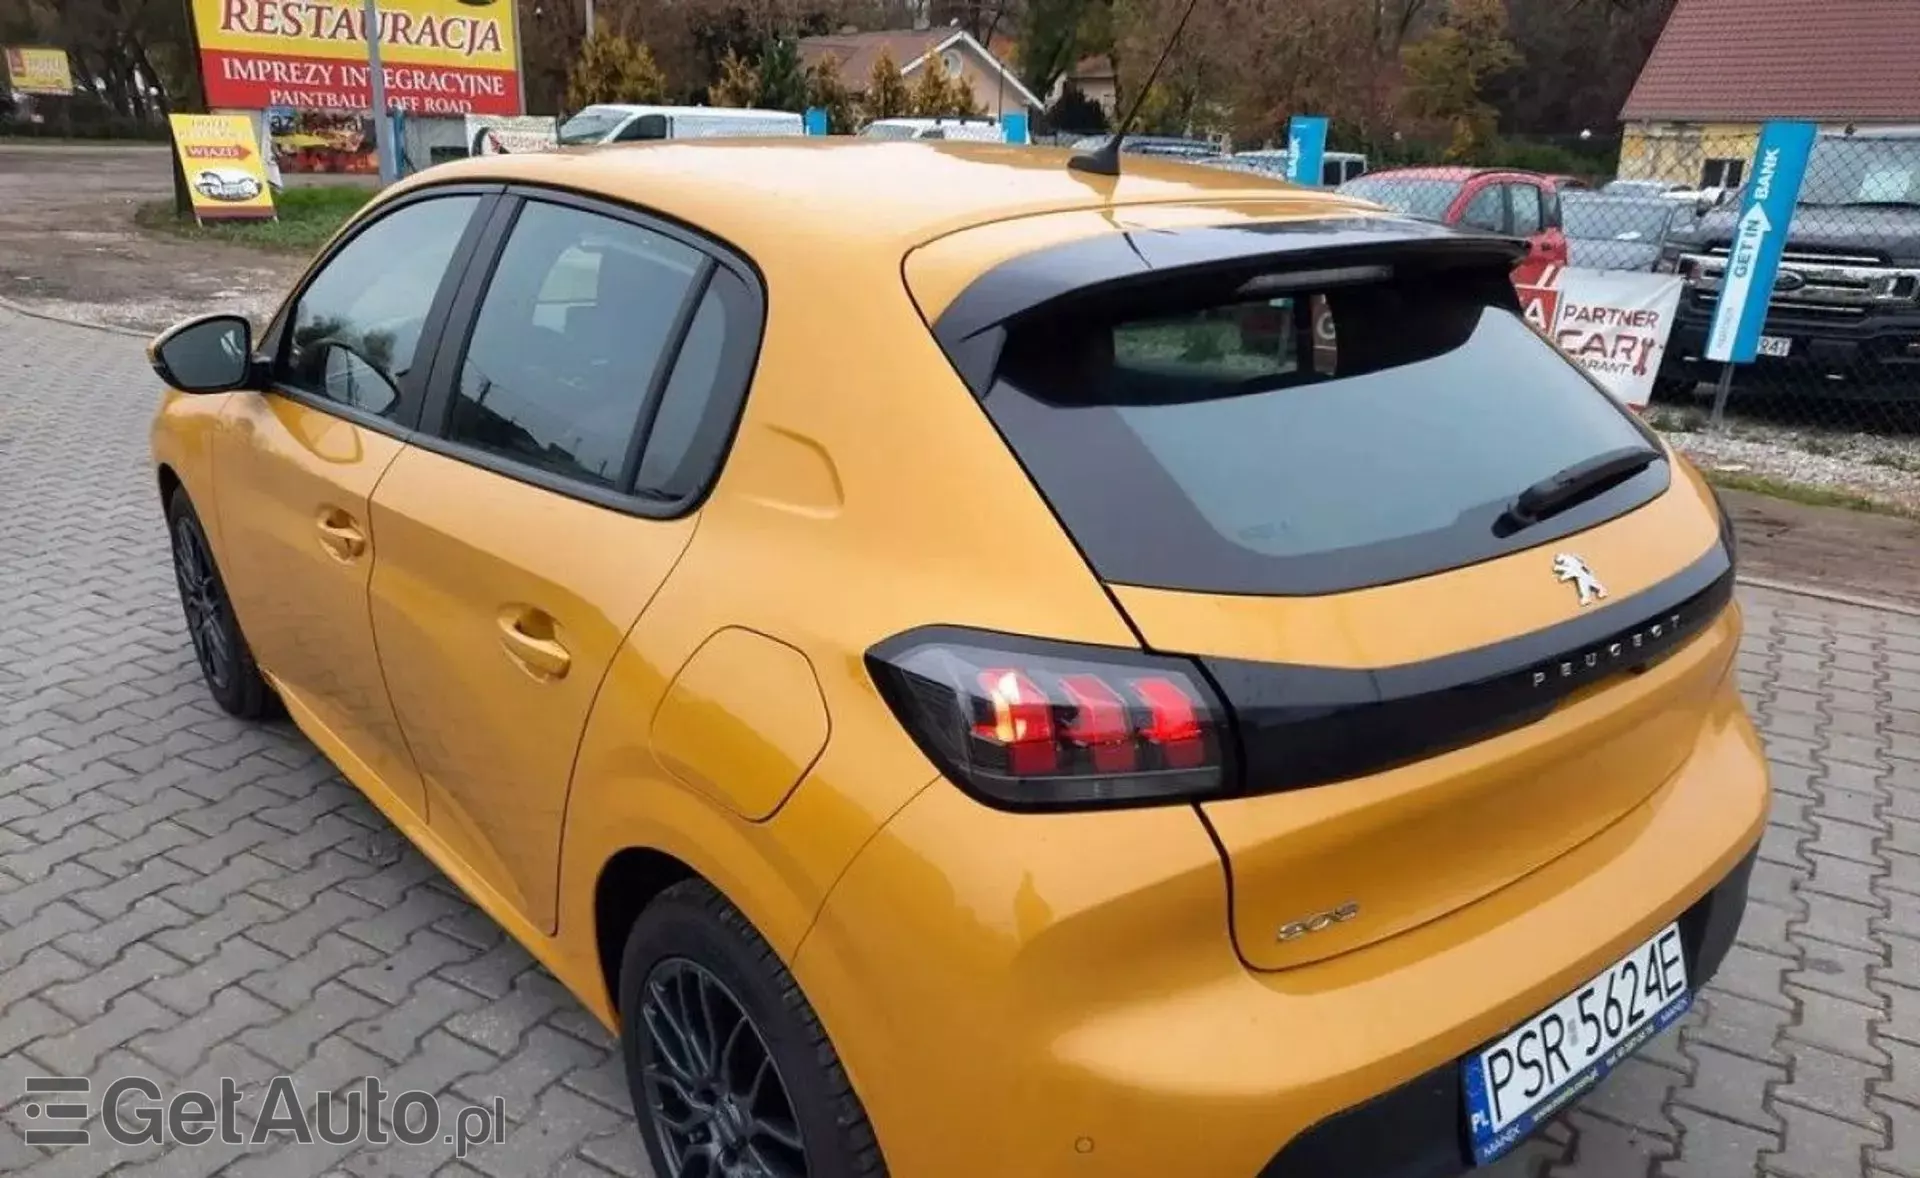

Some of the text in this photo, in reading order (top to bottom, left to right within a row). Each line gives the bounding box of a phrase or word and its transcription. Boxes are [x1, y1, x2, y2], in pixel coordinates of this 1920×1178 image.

[221, 0, 502, 56] RESTAURACJA
[222, 57, 505, 98] IMPREZY INEGRACYJNE
[270, 88, 473, 114] PAINTBALL OFF ROAD
[1733, 147, 1781, 278] GET IN BANK
[1563, 304, 1660, 329] PARTNER
[1576, 357, 1631, 376] ARANT
[1533, 614, 1680, 687] PEUGEOT
[1487, 1012, 1572, 1122] PSR
[1576, 929, 1684, 1057] 5624E
[1471, 1110, 1490, 1134] PL
